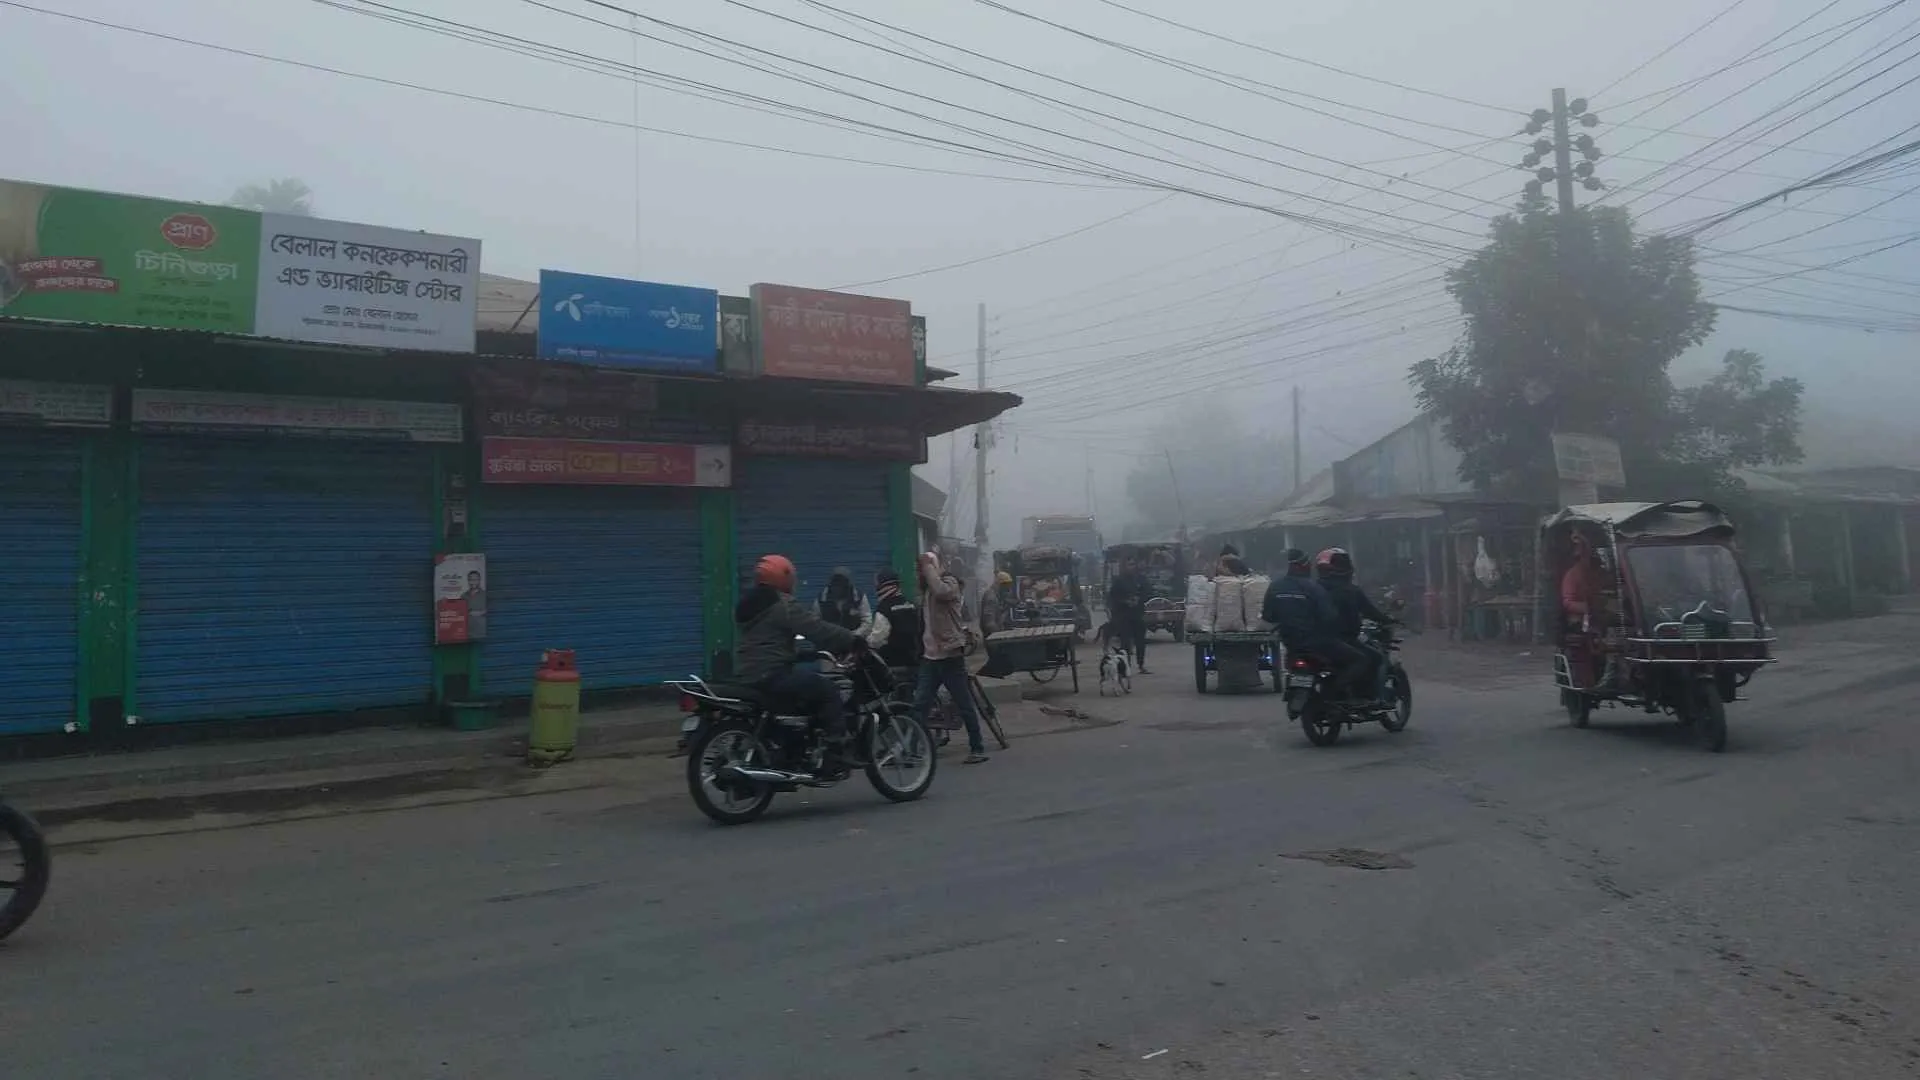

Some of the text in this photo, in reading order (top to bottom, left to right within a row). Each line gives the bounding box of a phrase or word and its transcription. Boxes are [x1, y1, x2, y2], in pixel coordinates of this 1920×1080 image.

[168, 222, 210, 244] প্রাণ
[270, 232, 470, 274] বেলাল কনফেকশনারী
[277, 267, 311, 288] এন্ড
[316, 269, 411, 297] ভ্যারাইটিজ
